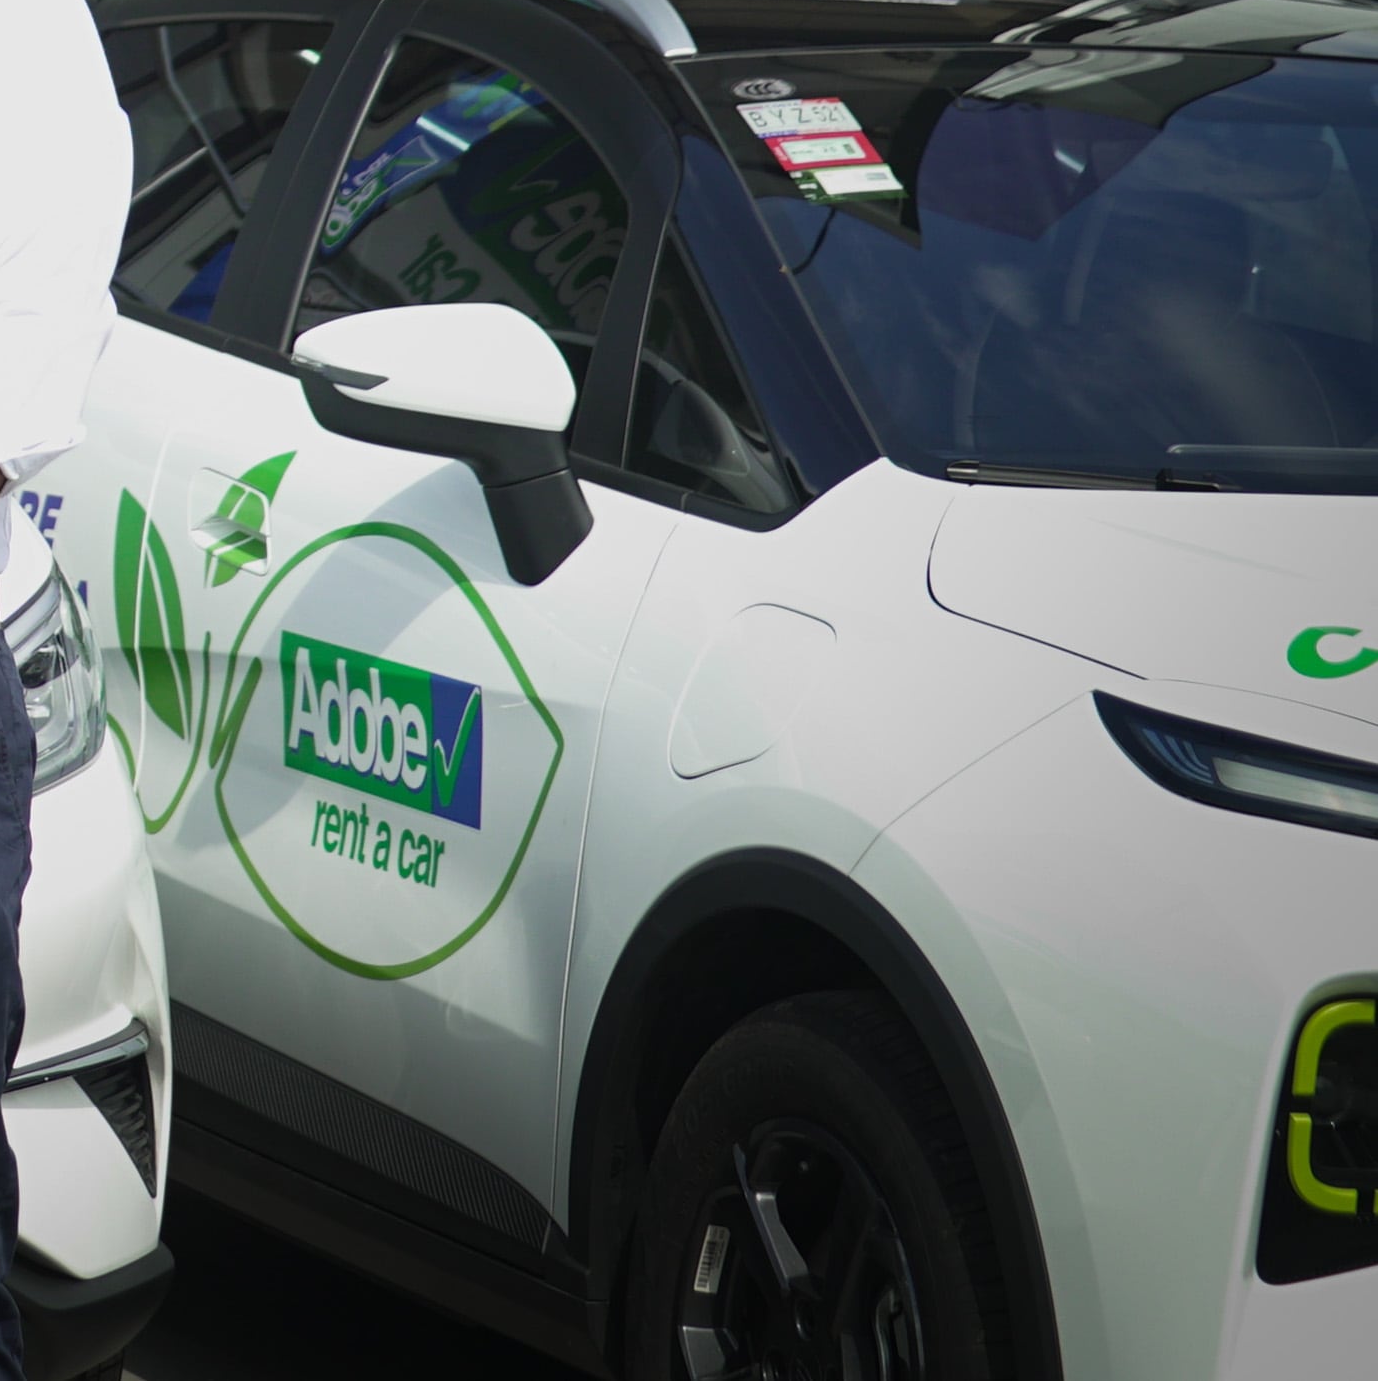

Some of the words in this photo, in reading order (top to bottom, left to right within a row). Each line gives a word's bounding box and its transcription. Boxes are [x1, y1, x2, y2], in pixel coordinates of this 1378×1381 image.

[287, 646, 428, 792] Adobe
[311, 800, 366, 861] rent
[372, 820, 390, 870] a
[397, 830, 445, 888] car
